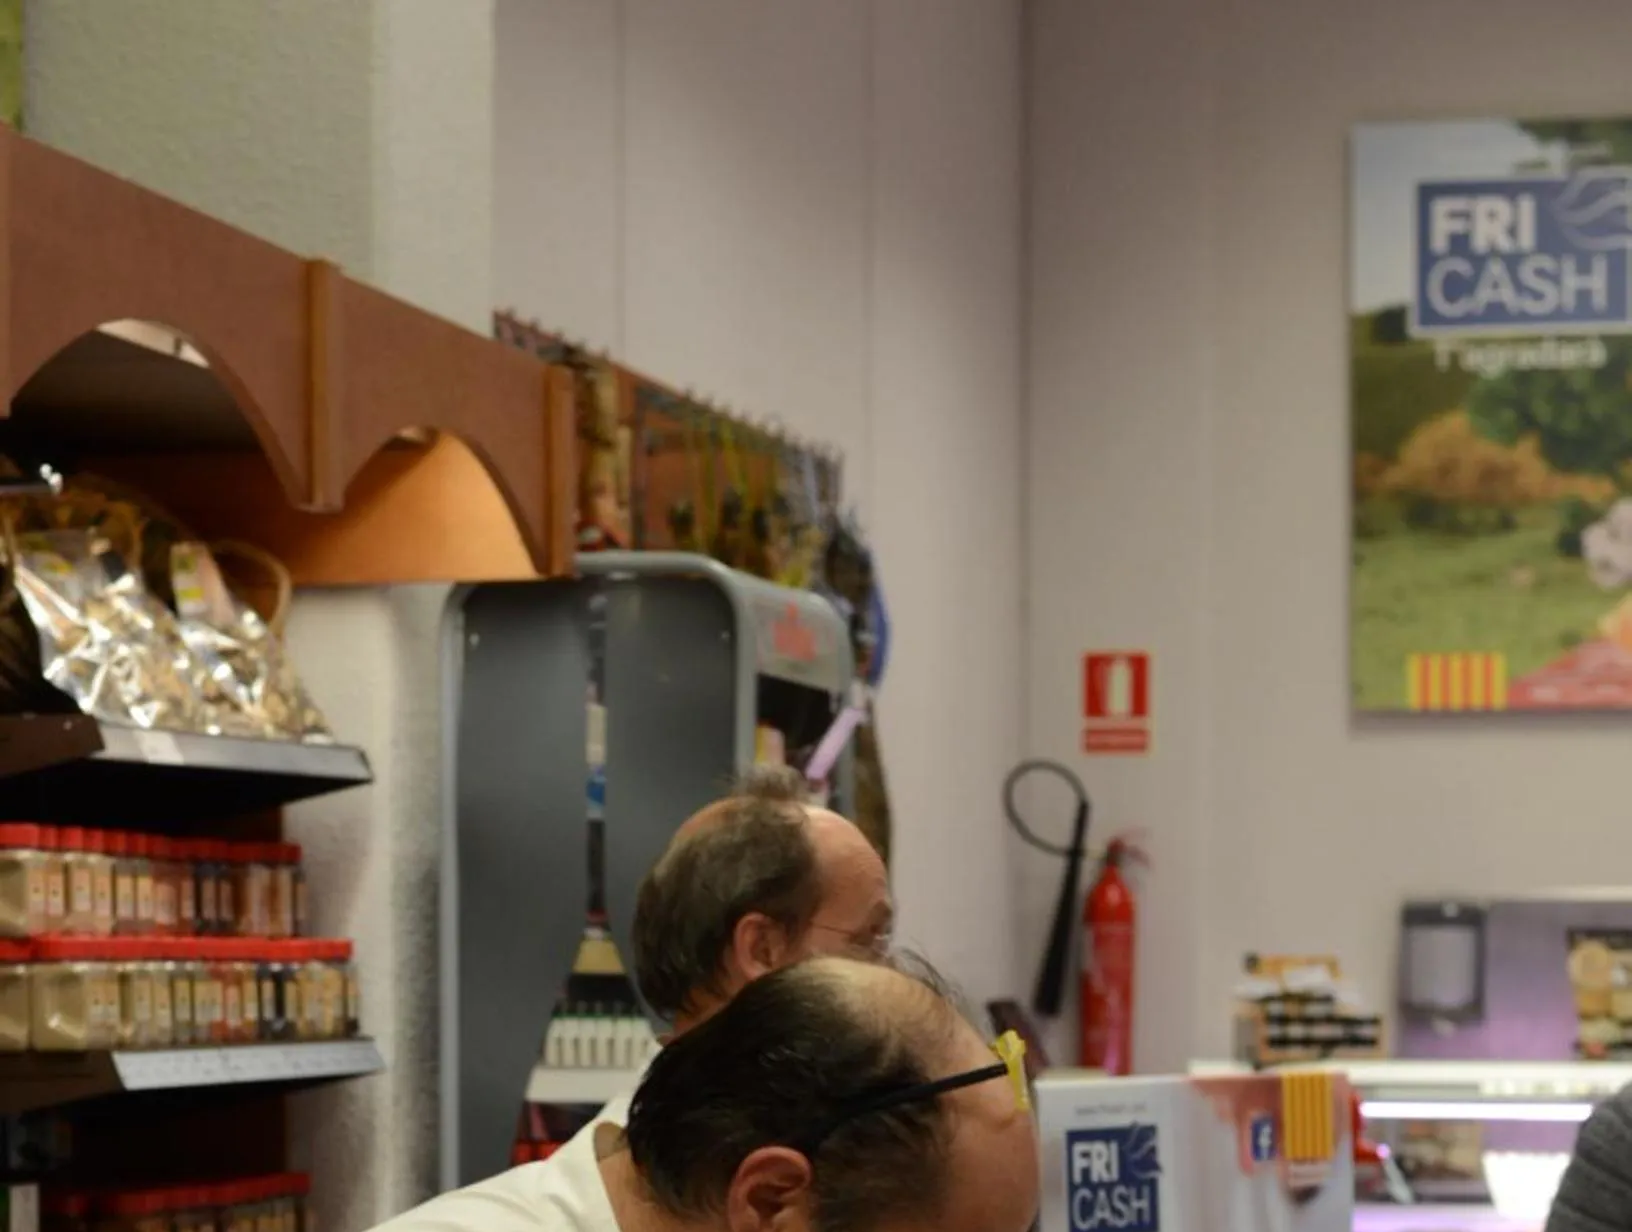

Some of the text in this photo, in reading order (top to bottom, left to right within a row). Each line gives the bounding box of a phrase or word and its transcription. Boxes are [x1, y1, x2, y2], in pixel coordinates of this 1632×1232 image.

[1429, 193, 1537, 256] FRI
[1427, 253, 1608, 319] CASH
[1072, 1141, 1119, 1184] FRI
[1071, 1185, 1150, 1230] CASH
